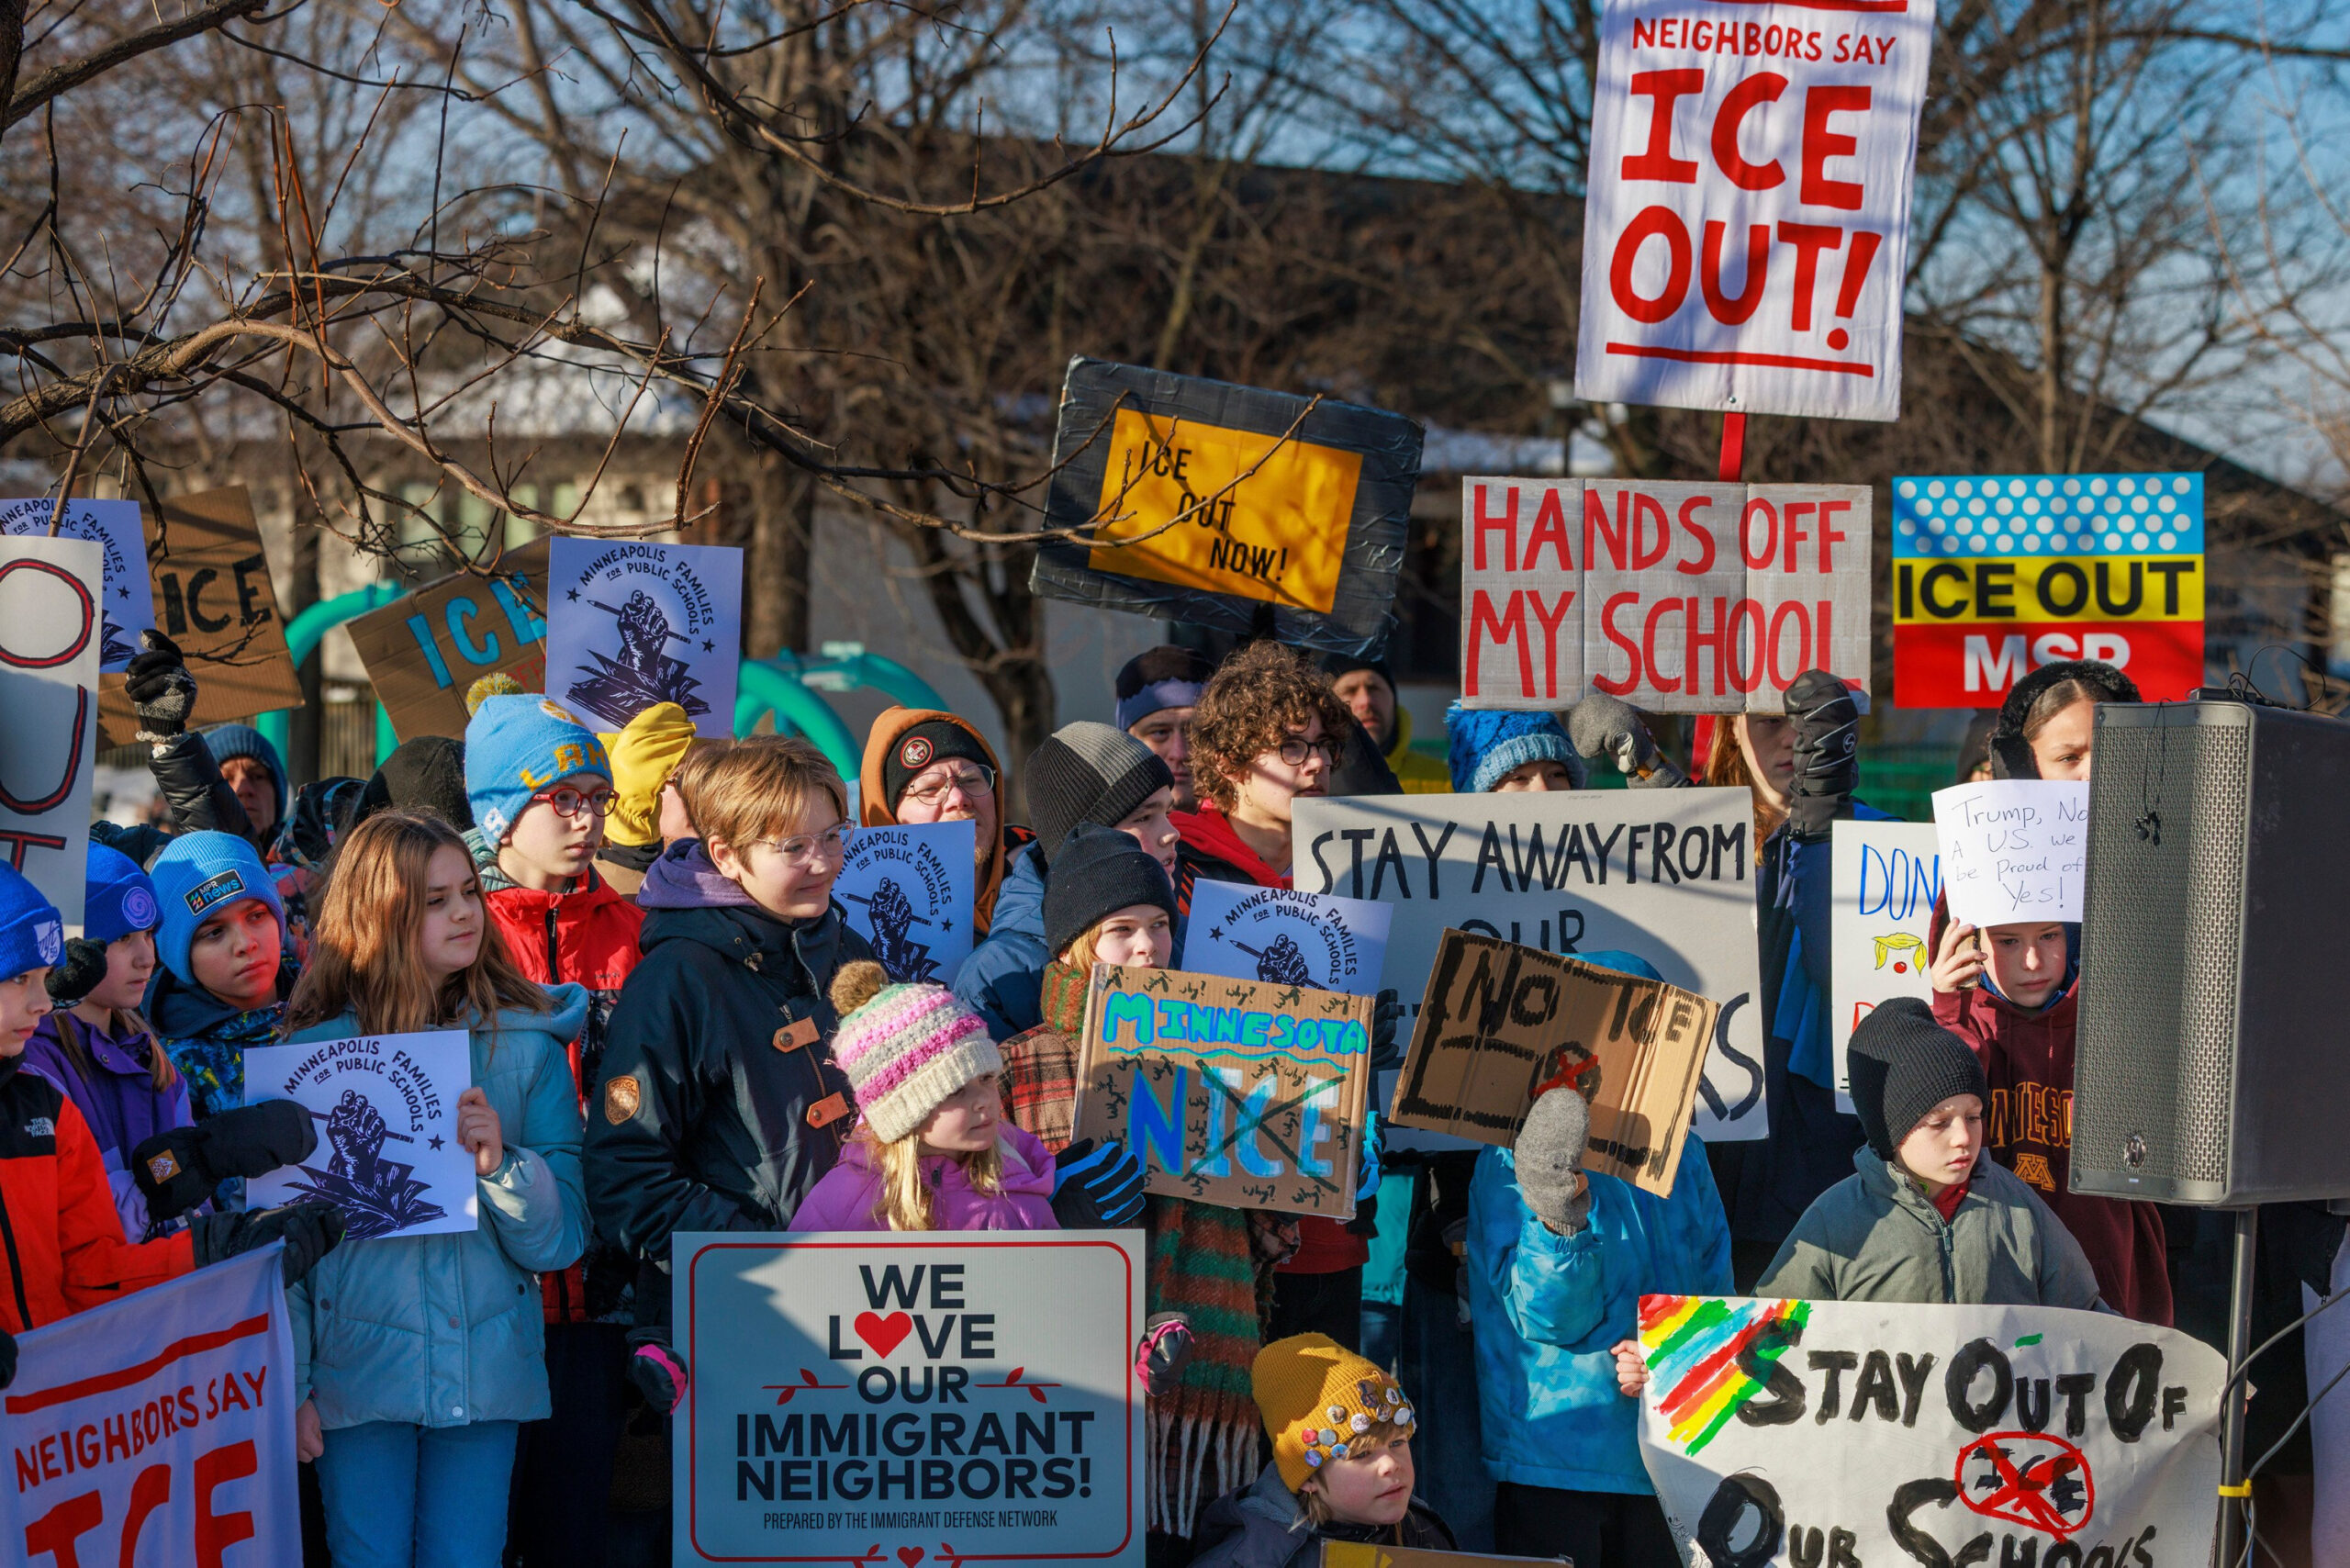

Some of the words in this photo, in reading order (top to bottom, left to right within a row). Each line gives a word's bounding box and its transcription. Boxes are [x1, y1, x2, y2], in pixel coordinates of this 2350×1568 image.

[1632, 17, 1821, 62] NEIGHBORS
[1833, 34, 1897, 65] SAY
[1621, 68, 1872, 210] ICE
[1610, 205, 1882, 351] OUT!
[1141, 441, 1192, 481] ICE
[13, 521, 29, 534] FOR
[83, 512, 127, 574] FAMILIES
[1177, 492, 1237, 532] OUT
[1473, 484, 1716, 576] HANDS
[1740, 497, 1852, 574] OFF
[579, 545, 666, 587] MINNEAPOLIS
[676, 560, 714, 626] FAMILIES
[1209, 537, 1288, 582] NOW!
[1899, 564, 2016, 619] ICE
[2037, 561, 2195, 617] OUT
[161, 554, 272, 635] ICE
[606, 566, 622, 580] FOR
[627, 561, 671, 580] PUBLIC
[672, 578, 699, 634] SCHOOLS
[406, 571, 547, 690] ICE
[1466, 589, 1576, 699] MY
[1592, 591, 1862, 696] SCHOOL
[1952, 796, 2042, 828] Trump,
[918, 842, 952, 905] FAMILIES
[1312, 821, 1458, 900] STAY
[1952, 840, 1964, 861] A
[1987, 828, 2034, 853] U.S.
[1956, 866, 1980, 882] be
[2062, 857, 2084, 872] of
[198, 880, 218, 895] MPR
[203, 879, 241, 904] news
[856, 856, 870, 869] FOR
[874, 848, 912, 864] PUBLIC
[915, 860, 938, 916] SCHOOLS
[2003, 876, 2065, 912] Yes!
[1225, 889, 1319, 926] MINNEAPOLIS
[1326, 907, 1357, 976] FAMILIES
[1254, 908, 1270, 922] FOR
[1276, 905, 1320, 926] PUBLIC
[1319, 925, 1340, 985] SCHOOLS
[1226, 984, 1256, 1006] why?
[1458, 944, 1560, 1037] NO
[1102, 991, 1369, 1055] MINNESOTA
[284, 1039, 380, 1095] MINNEAPOLIS
[392, 1050, 442, 1120] FAMILIES
[313, 1069, 331, 1083] FOR
[336, 1058, 386, 1074] PUBLIC
[388, 1070, 424, 1132] SCHOOLS
[1127, 1063, 1341, 1179] NICE
[1243, 1184, 1276, 1204] why?
[859, 1264, 965, 1309] WE
[857, 1366, 969, 1404] OUR
[1738, 1317, 1939, 1428] STAY
[1945, 1338, 2097, 1435] OUT
[2105, 1343, 2188, 1443] OF
[15, 1385, 199, 1494] NEIGHBORS
[207, 1366, 267, 1421] SAY
[737, 1411, 1095, 1457] IMMIGRANT
[25, 1439, 259, 1568] ICE
[737, 1457, 1092, 1501] NEIGHBORS!
[1972, 1447, 2086, 1514] ICE
[764, 1513, 823, 1529] PREPARED
[827, 1512, 843, 1529] BY
[845, 1512, 867, 1529] THE
[871, 1511, 941, 1529] IMMIGRANT
[944, 1511, 995, 1529] DEFENSE
[998, 1510, 1058, 1528] NETWORK
[1696, 1470, 1863, 1568] OUR
